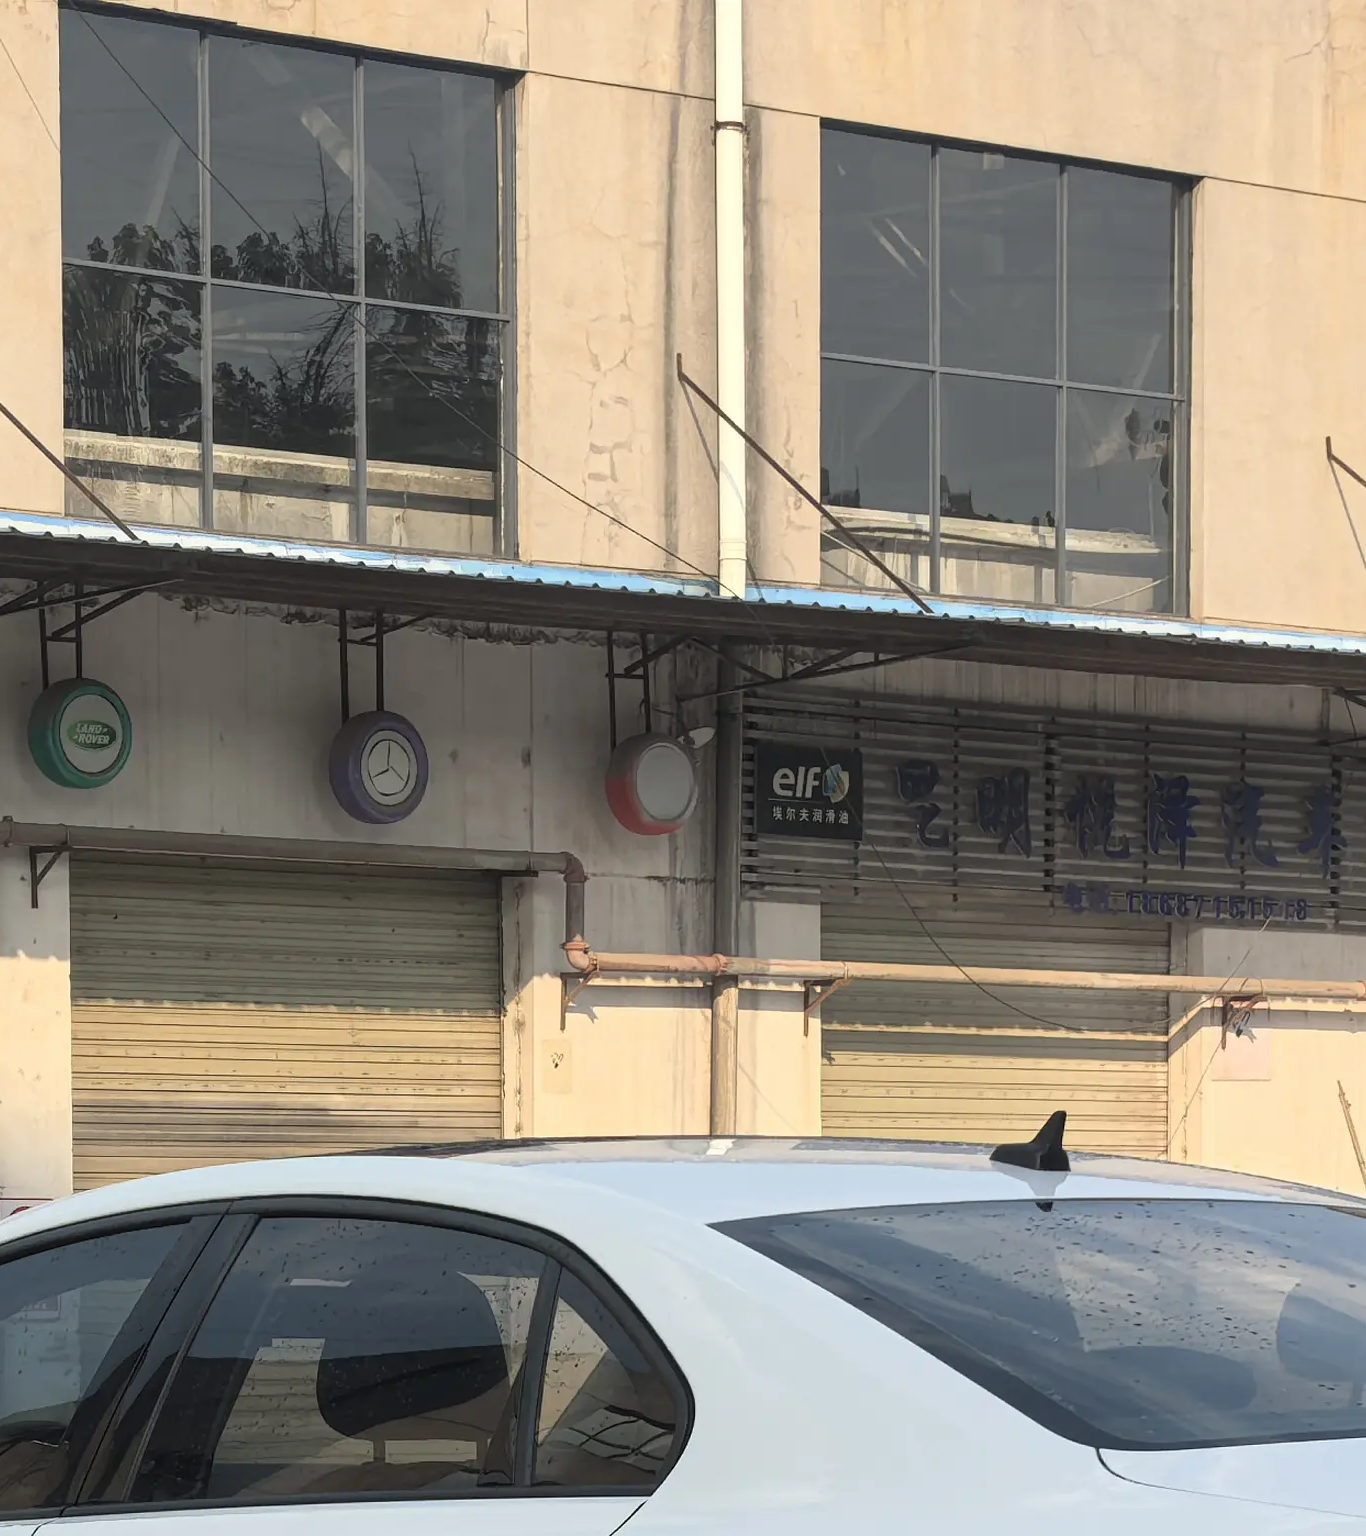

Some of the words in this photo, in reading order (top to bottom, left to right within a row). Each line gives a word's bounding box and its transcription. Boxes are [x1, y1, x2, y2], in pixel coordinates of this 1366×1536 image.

[75, 723, 103, 734] LAND
[78, 733, 110, 745] ROVER
[772, 765, 822, 799] elf
[772, 804, 849, 825] 埃尔夫润滑油
